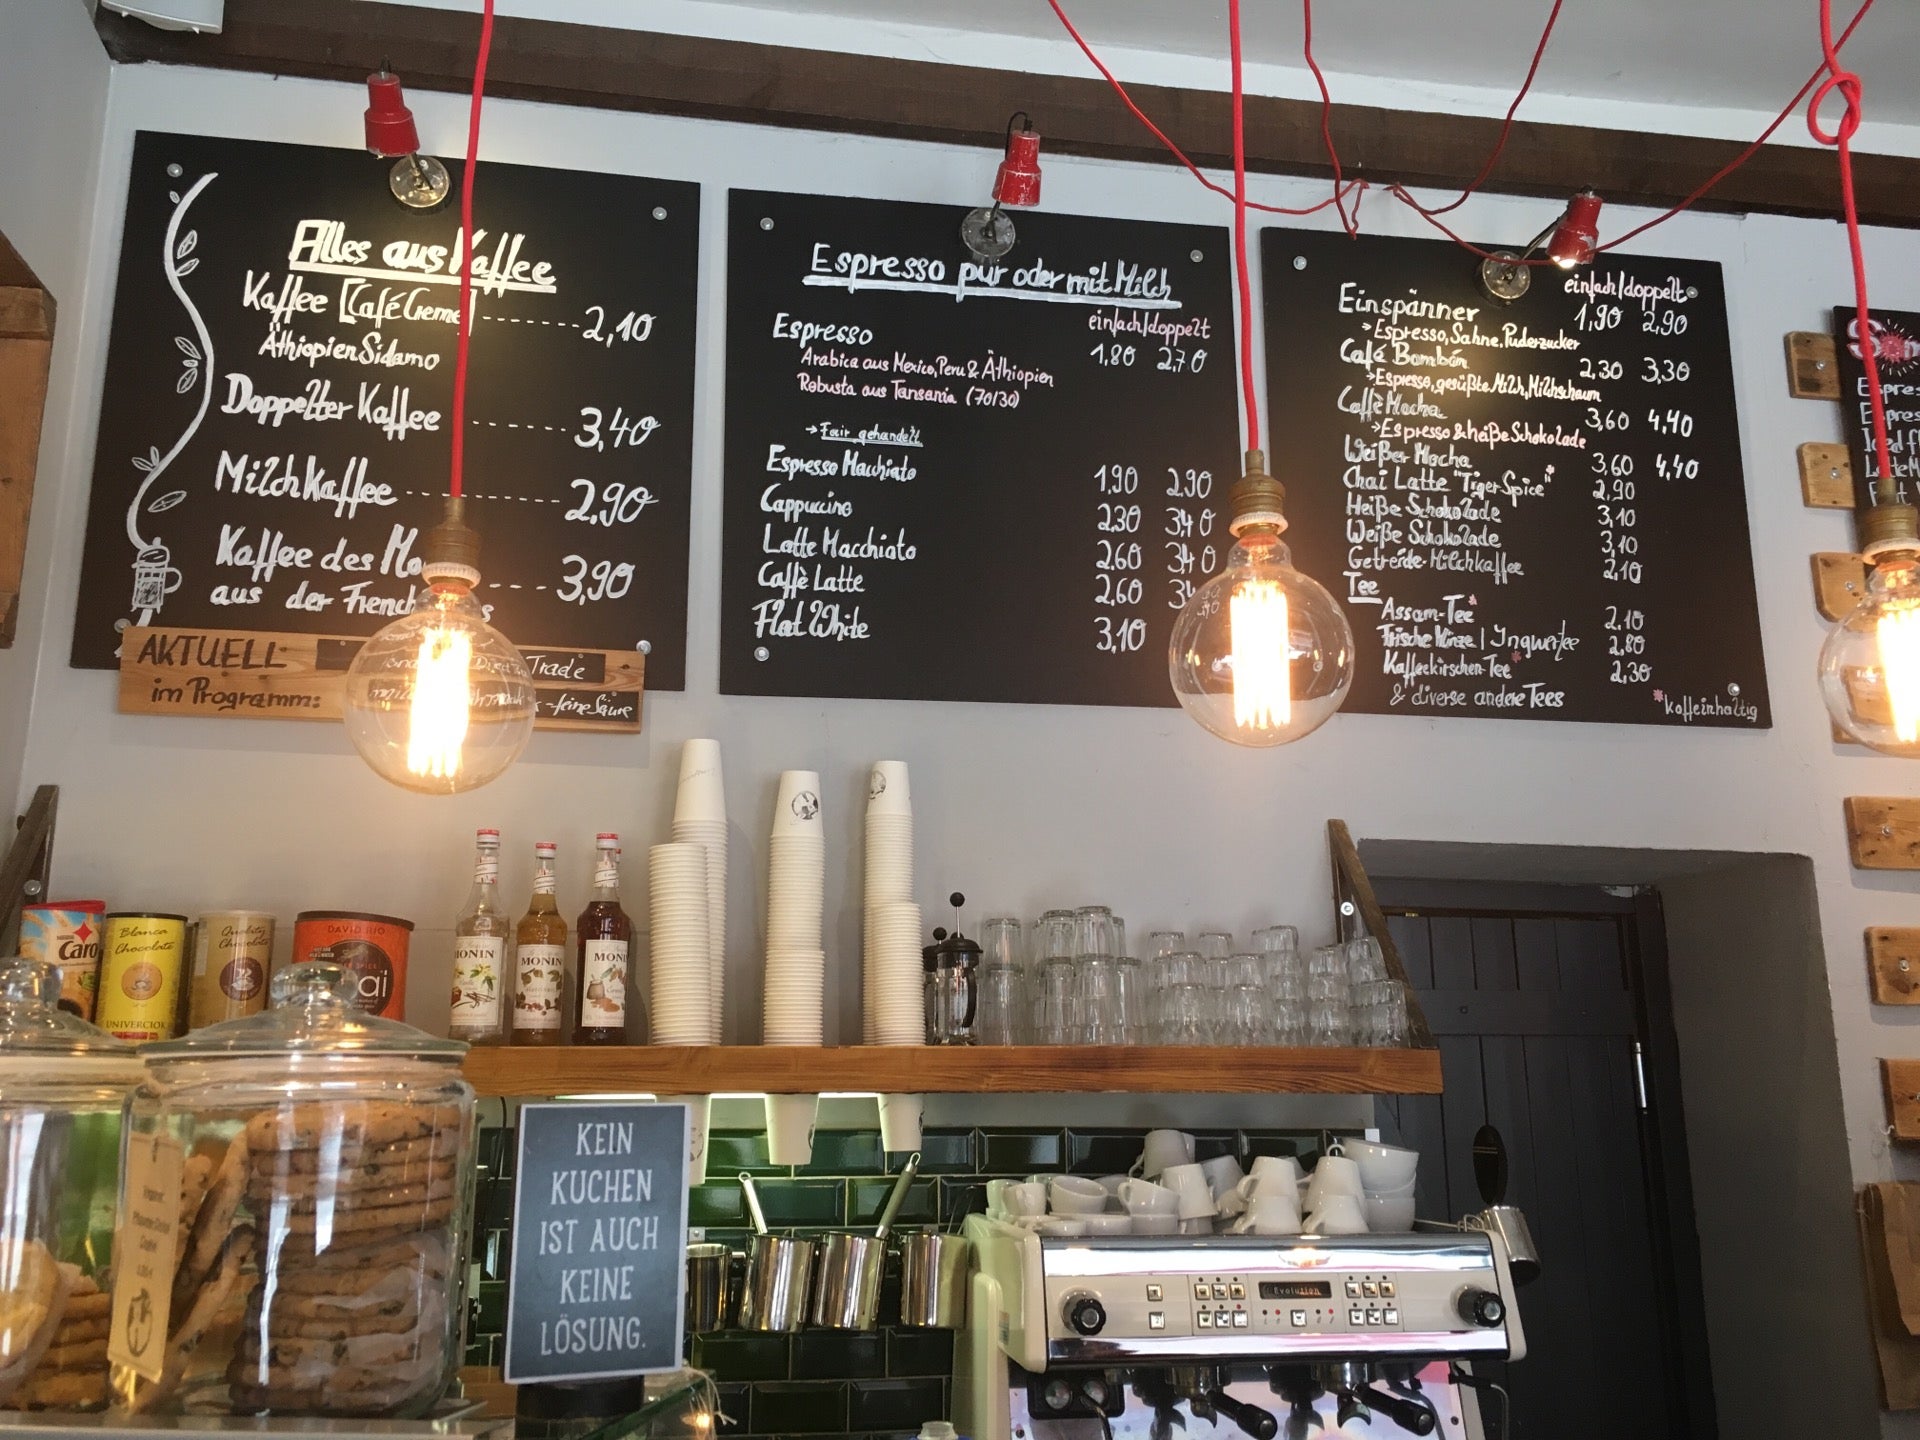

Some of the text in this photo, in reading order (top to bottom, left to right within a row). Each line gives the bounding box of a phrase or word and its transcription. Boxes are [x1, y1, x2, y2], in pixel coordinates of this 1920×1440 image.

[288, 219, 556, 298] Alles aus Kaffee
[811, 242, 1172, 302] Espresso pur oder mit Milch
[242, 269, 328, 324] Kaffee
[582, 306, 657, 348] 2,10
[1338, 282, 1480, 325] Einspänner
[258, 322, 440, 371] Äthiopien Sidamo
[772, 312, 873, 349] Espresso
[1504, 323, 1581, 351] Puderzucker
[800, 346, 859, 369] Arabica
[862, 358, 889, 372] aus
[935, 355, 964, 376] Peru
[967, 360, 979, 378] &
[981, 348, 1054, 388] Äthiopien
[1090, 343, 1208, 373] 1,80 2,70
[1339, 338, 1389, 370] Café
[797, 372, 857, 396] Robusta
[862, 384, 887, 398] aus
[891, 379, 958, 404] Tansania
[1435, 373, 1491, 398] gesüßte
[1528, 374, 1602, 402] Milchschaum
[220, 373, 662, 452] Doppelter Kaffee 3,40
[820, 421, 921, 446] Fair gehandelt
[1379, 418, 1587, 450] Espresso & heiße Schokolade
[766, 445, 838, 481] Espresso
[842, 449, 917, 481] Macchiato
[1343, 434, 1410, 466] Weißer
[1414, 443, 1473, 470] Mocha
[1342, 465, 1388, 491] Chai
[1394, 468, 1452, 492] Latte
[760, 483, 853, 523] Cappuccino
[1347, 491, 1402, 524] Heiße
[1406, 492, 1502, 524] Schokolade
[763, 523, 818, 557] Latte
[822, 526, 918, 562] Macchiato
[1345, 518, 1402, 547] Weiße
[1408, 518, 1502, 549] Schokolade
[215, 523, 314, 583] Kaffee
[320, 536, 375, 573] des
[209, 585, 264, 606] aus
[285, 580, 335, 612] der
[556, 554, 636, 606] 3,90
[757, 560, 809, 600] Caffè
[814, 564, 866, 593] Latte
[1343, 571, 1380, 595] Tee
[752, 599, 806, 639] Flat
[808, 600, 871, 642] White
[1377, 624, 1433, 648] Frische
[137, 633, 287, 669] AKTUELL
[525, 655, 586, 680] Trade
[151, 676, 321, 712] im Programm:
[1389, 681, 1564, 709] & diverse andere Tees
[120, 927, 168, 938] Blanca
[218, 937, 269, 950] Chocolate
[327, 925, 386, 935] DAVID RIO
[58, 940, 98, 960] Caro
[115, 940, 175, 956] Chocolate
[521, 957, 563, 966] MONIN
[576, 1122, 633, 1156] KEIN
[551, 1169, 653, 1205] KUCHEN
[539, 1216, 659, 1255] IST AUCH
[559, 1265, 634, 1304] KEINE
[541, 1313, 647, 1356] LÖSUNG.
